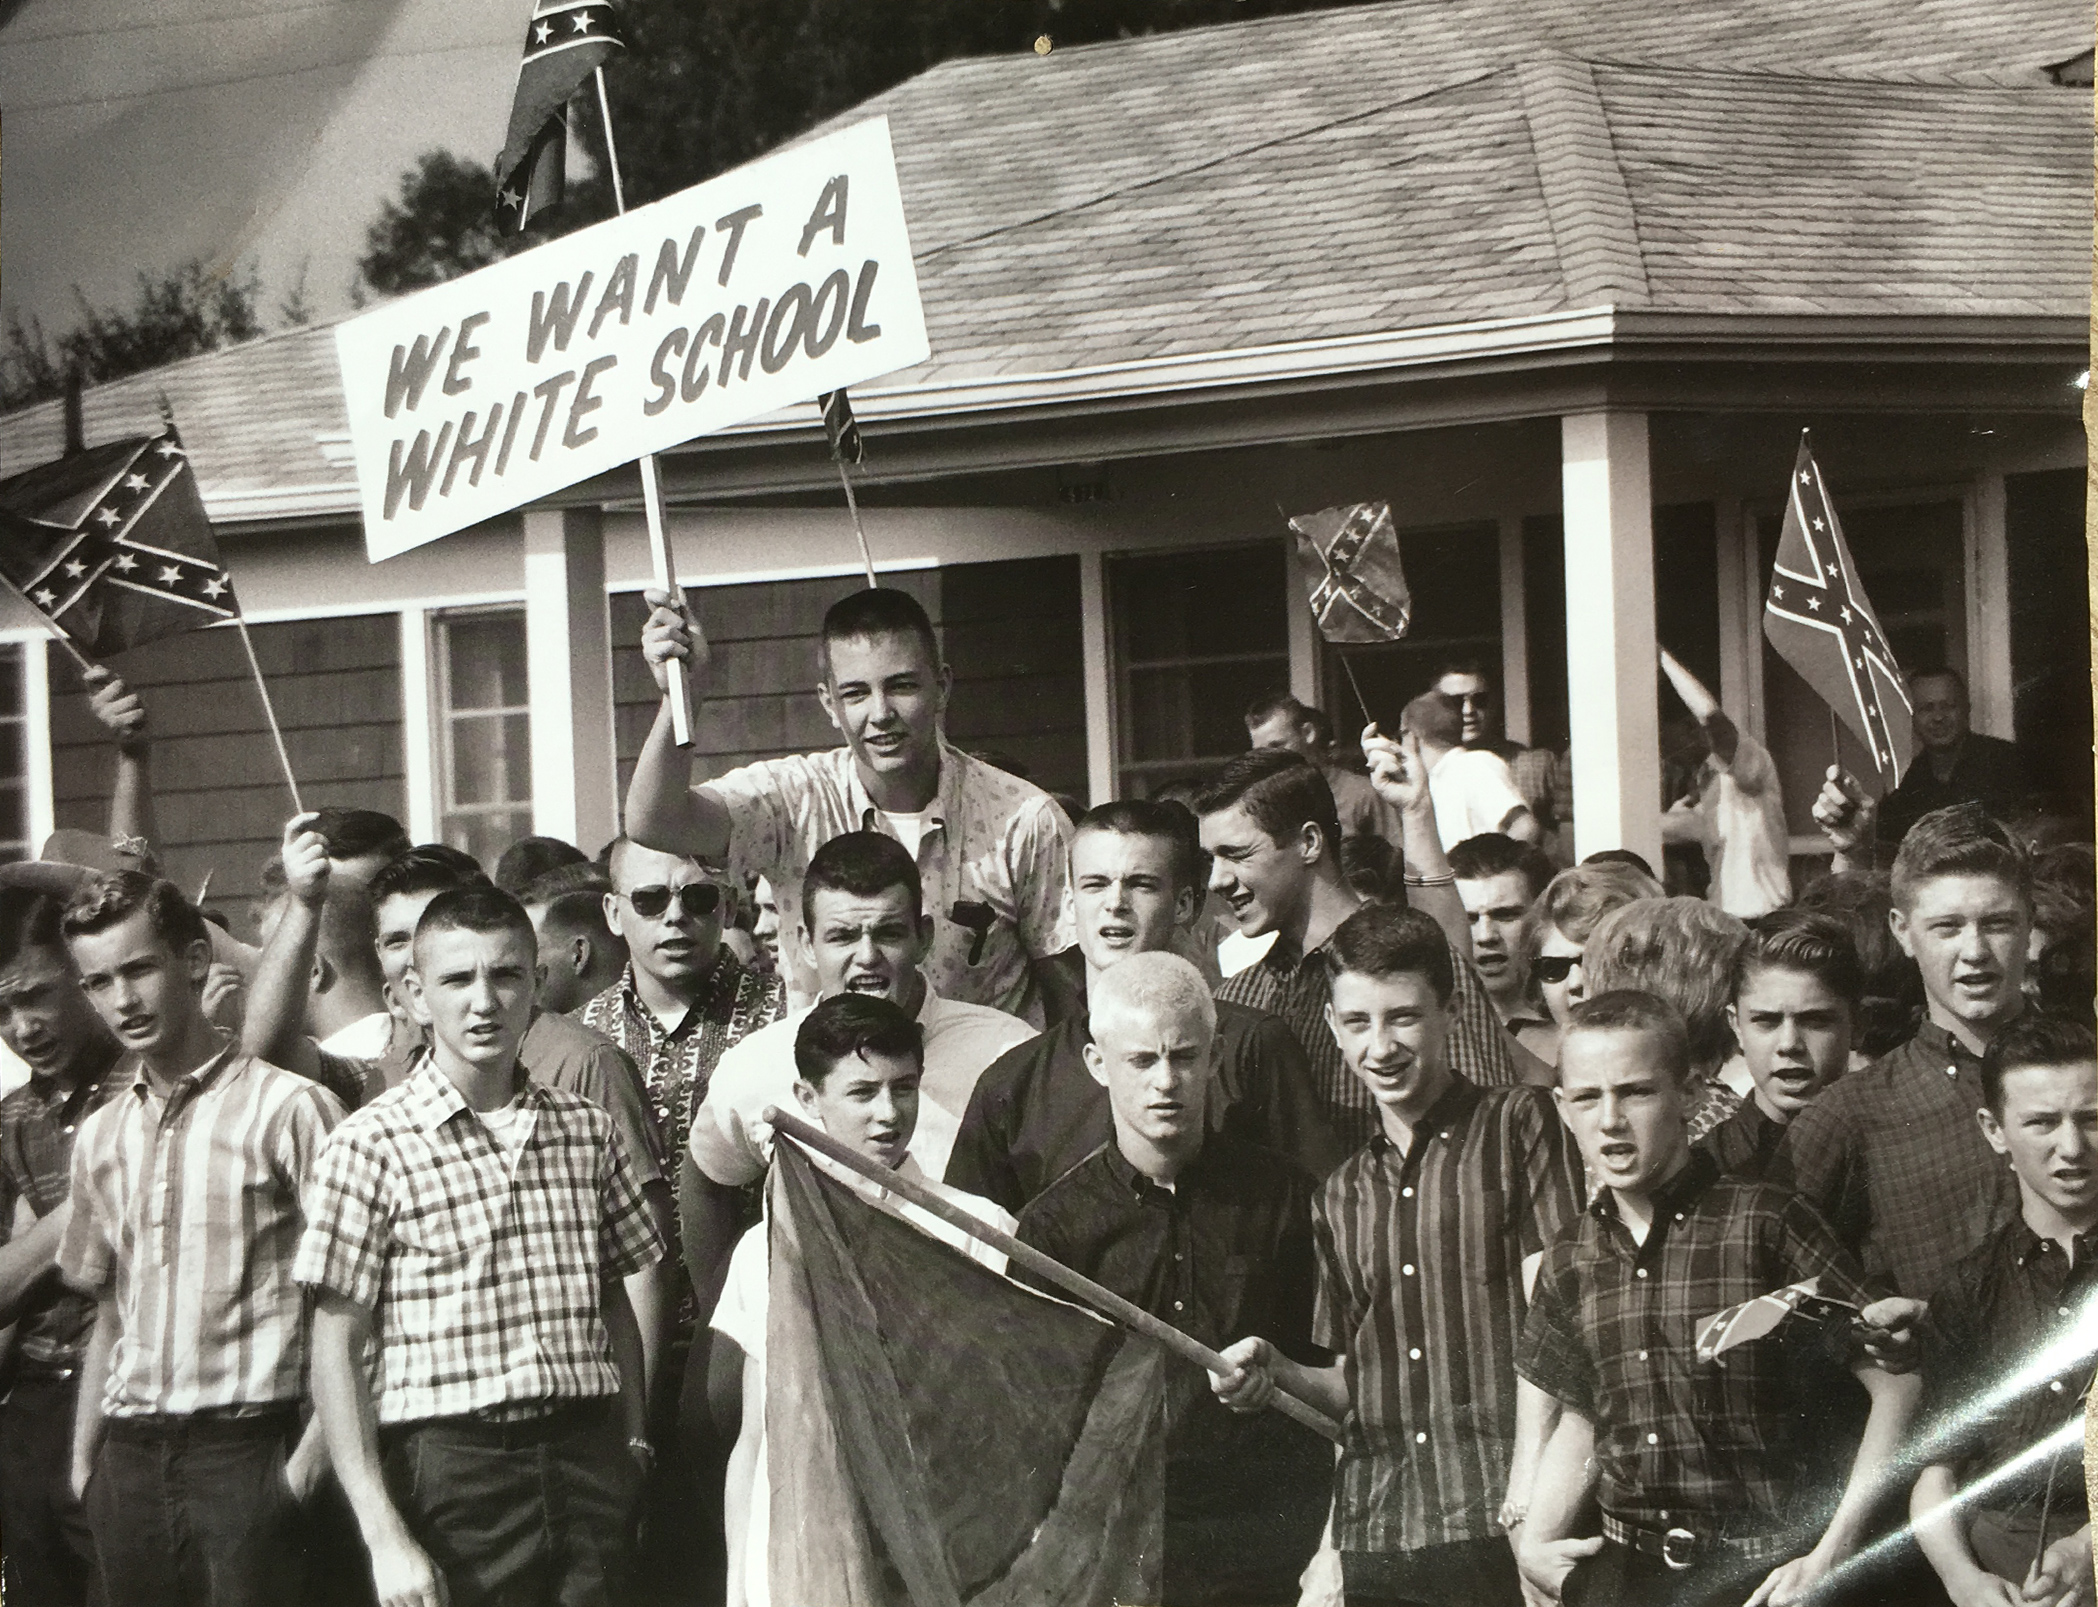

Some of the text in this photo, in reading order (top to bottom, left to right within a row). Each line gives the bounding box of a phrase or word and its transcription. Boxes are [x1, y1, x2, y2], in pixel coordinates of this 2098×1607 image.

[383, 260, 881, 520] WHITE SCHOOL
[384, 175, 848, 419] WE WANT A
